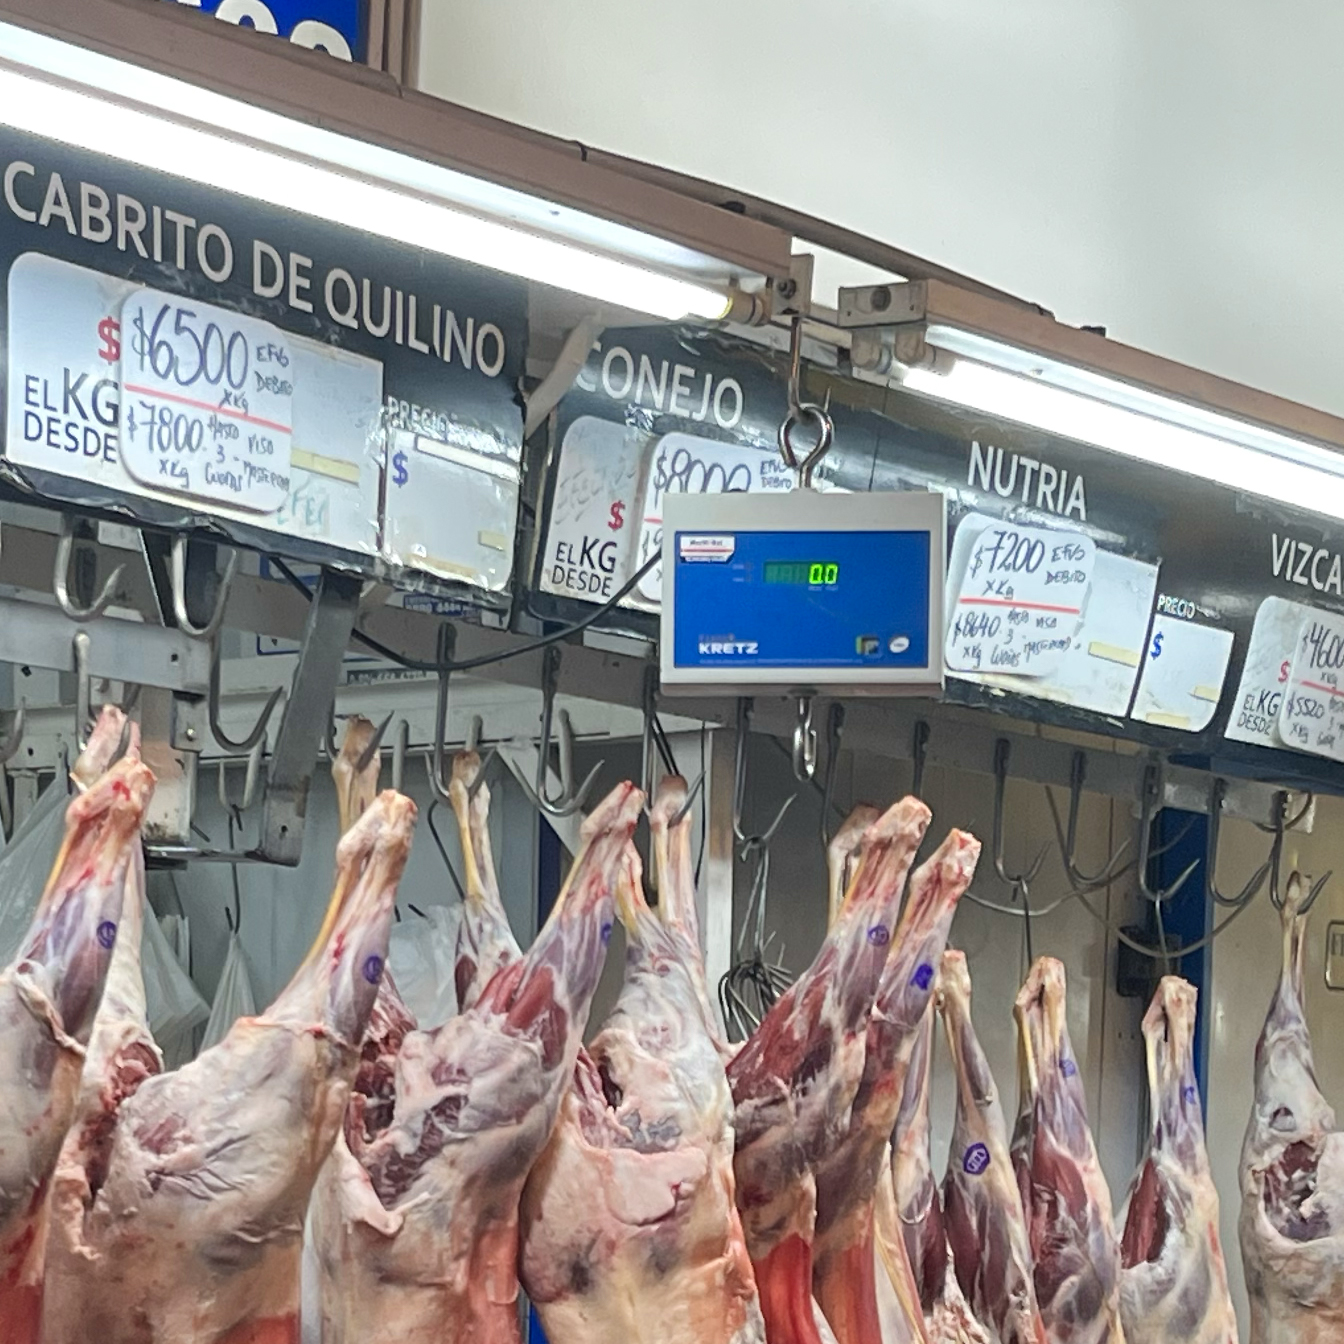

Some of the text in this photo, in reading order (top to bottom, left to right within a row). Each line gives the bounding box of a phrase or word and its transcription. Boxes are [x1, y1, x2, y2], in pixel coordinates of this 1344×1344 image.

[4, 160, 506, 378] CABRITO DE QUILINO
[98, 316, 120, 366] $
[131, 304, 248, 390] $6500
[25, 367, 119, 428] EL KG
[24, 410, 118, 463] DESDE
[392, 450, 409, 488] $
[968, 440, 1087, 521] NUTRIA
[608, 500, 626, 532] $
[556, 541, 577, 565] EL
[580, 536, 618, 574] KG
[969, 530, 1046, 580] $7200
[552, 565, 613, 598] DESDE
[1157, 593, 1196, 619] PRECIO
[699, 642, 759, 655] KRETZ
[1150, 631, 1164, 660] $
[1278, 660, 1291, 684] $
[1243, 689, 1282, 717] EL KG
[1237, 711, 1271, 737] DESDE
